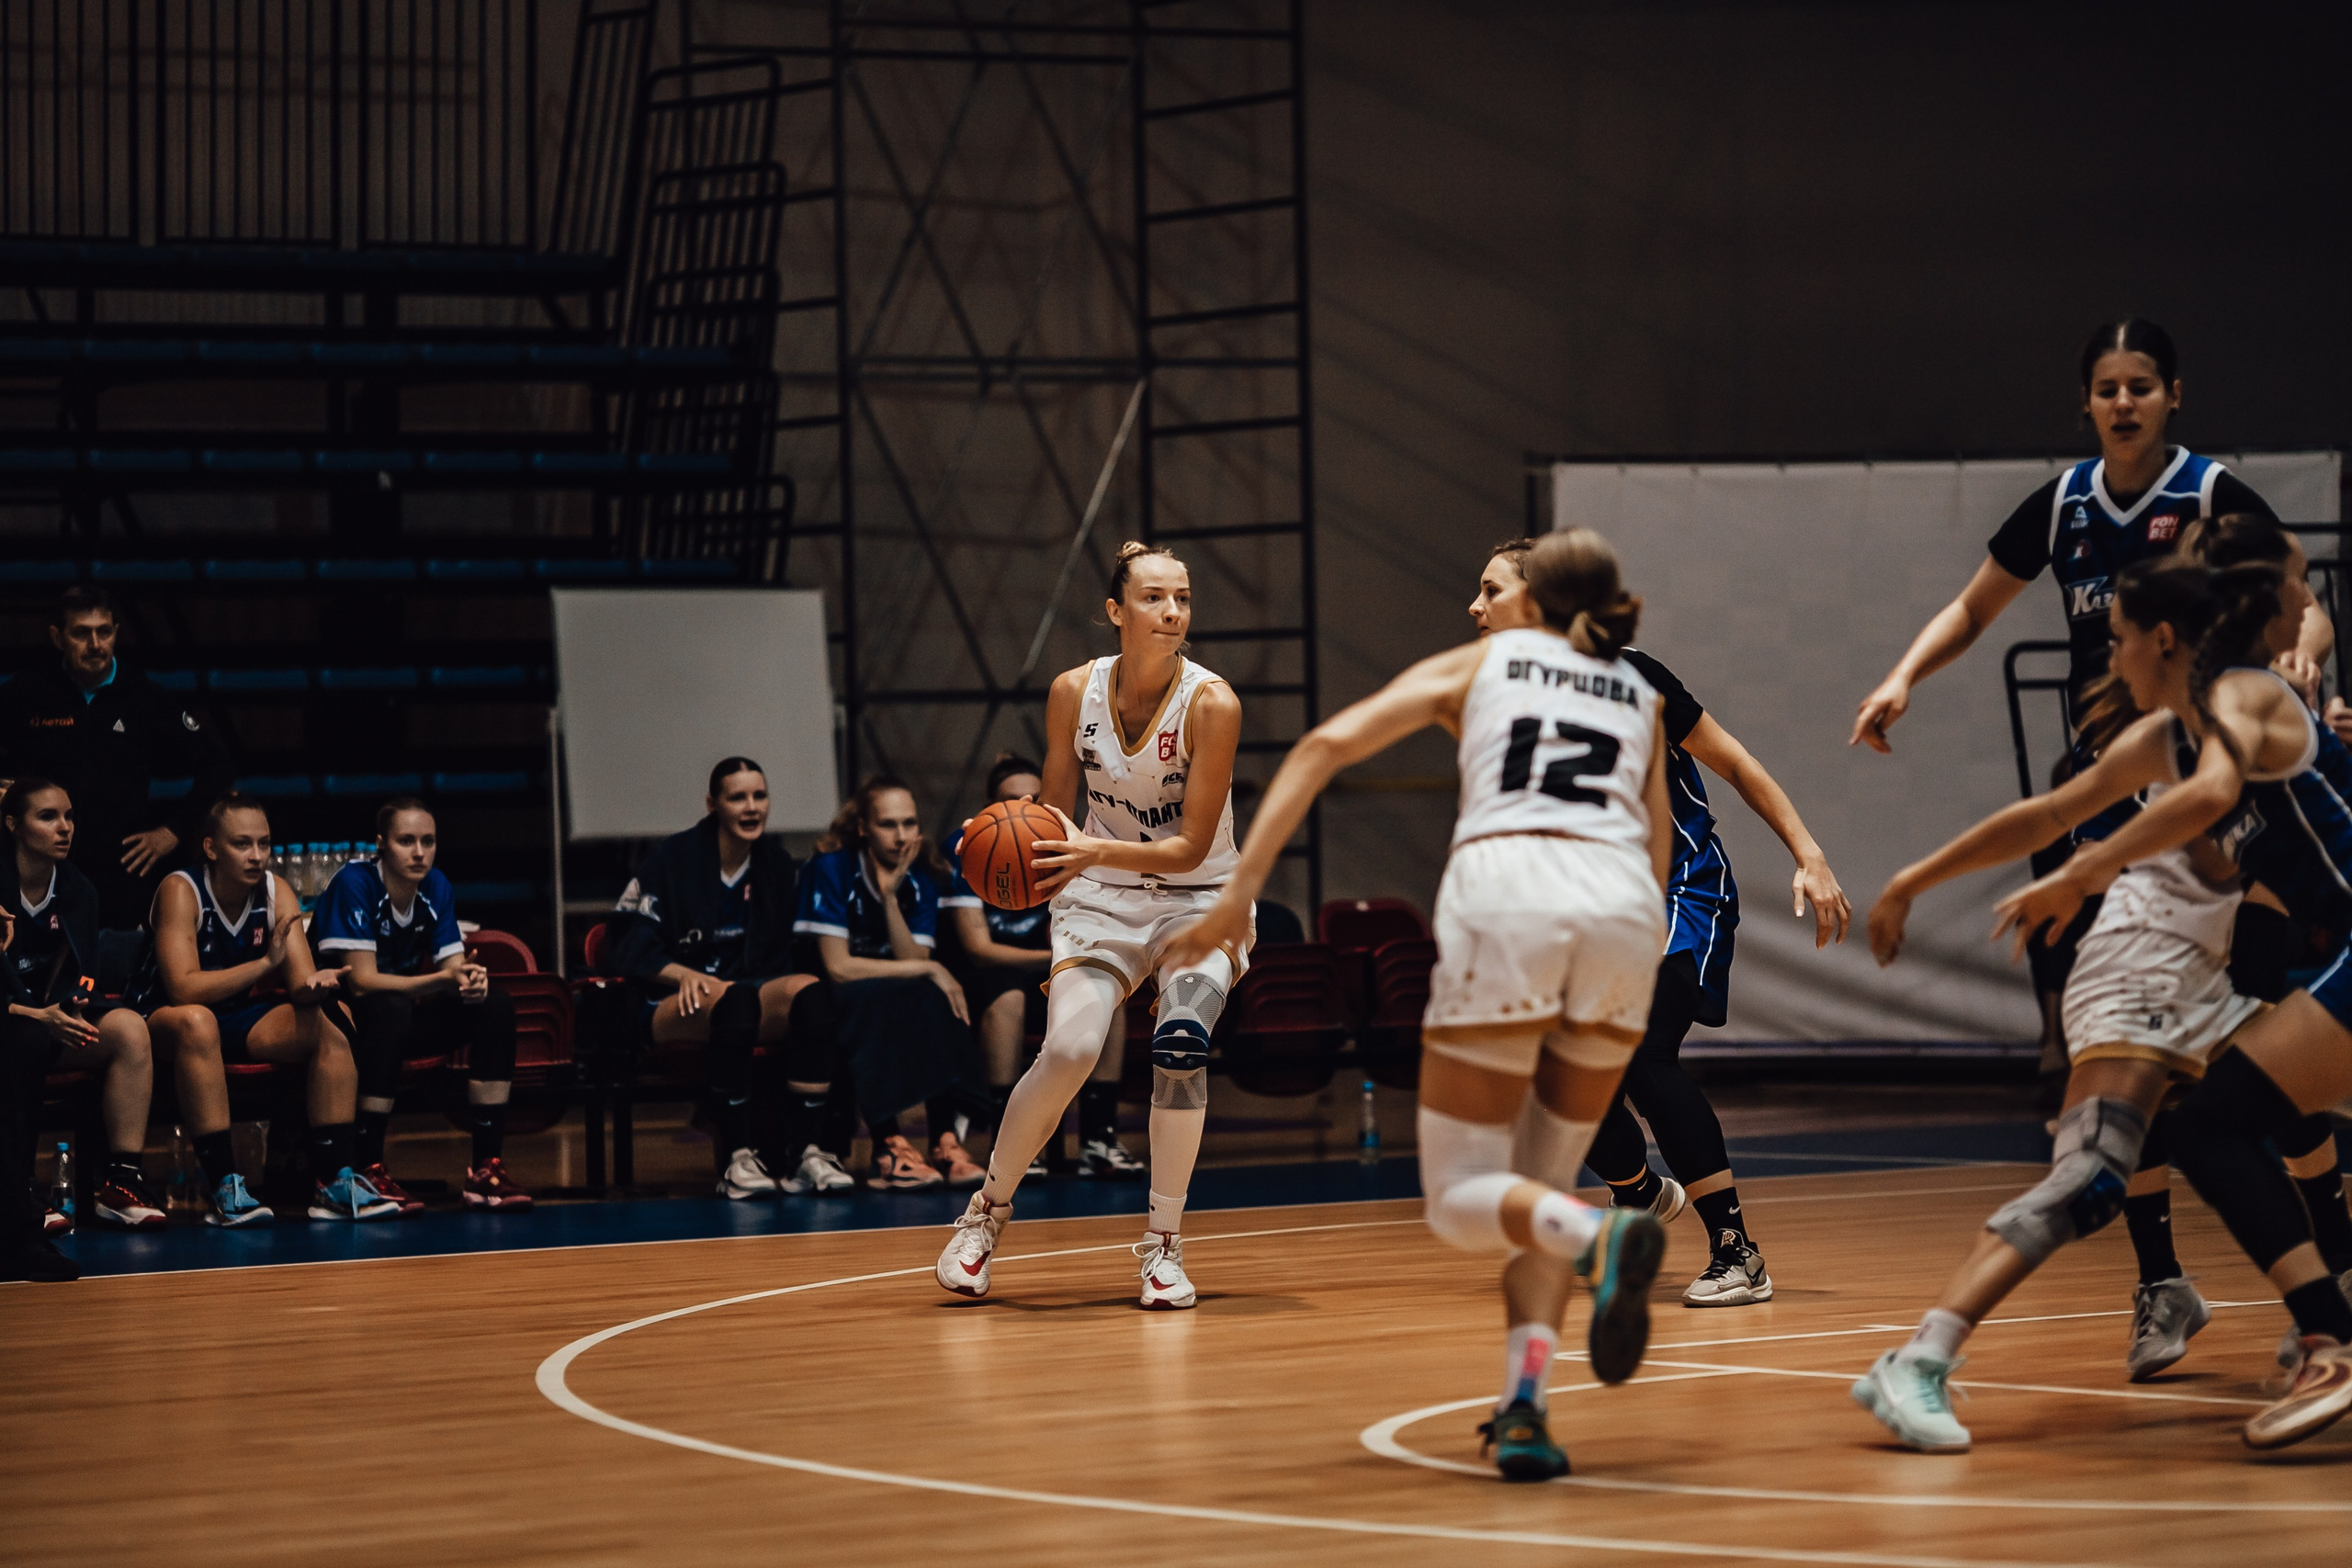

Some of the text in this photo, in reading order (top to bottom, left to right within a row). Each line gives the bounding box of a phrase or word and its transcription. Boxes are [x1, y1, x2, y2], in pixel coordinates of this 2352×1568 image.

[2149, 527, 2177, 539] BET
[2151, 516, 2179, 528] FON
[1507, 660, 1639, 709] ОГУРЦОВА
[1500, 717, 1620, 809] 12
